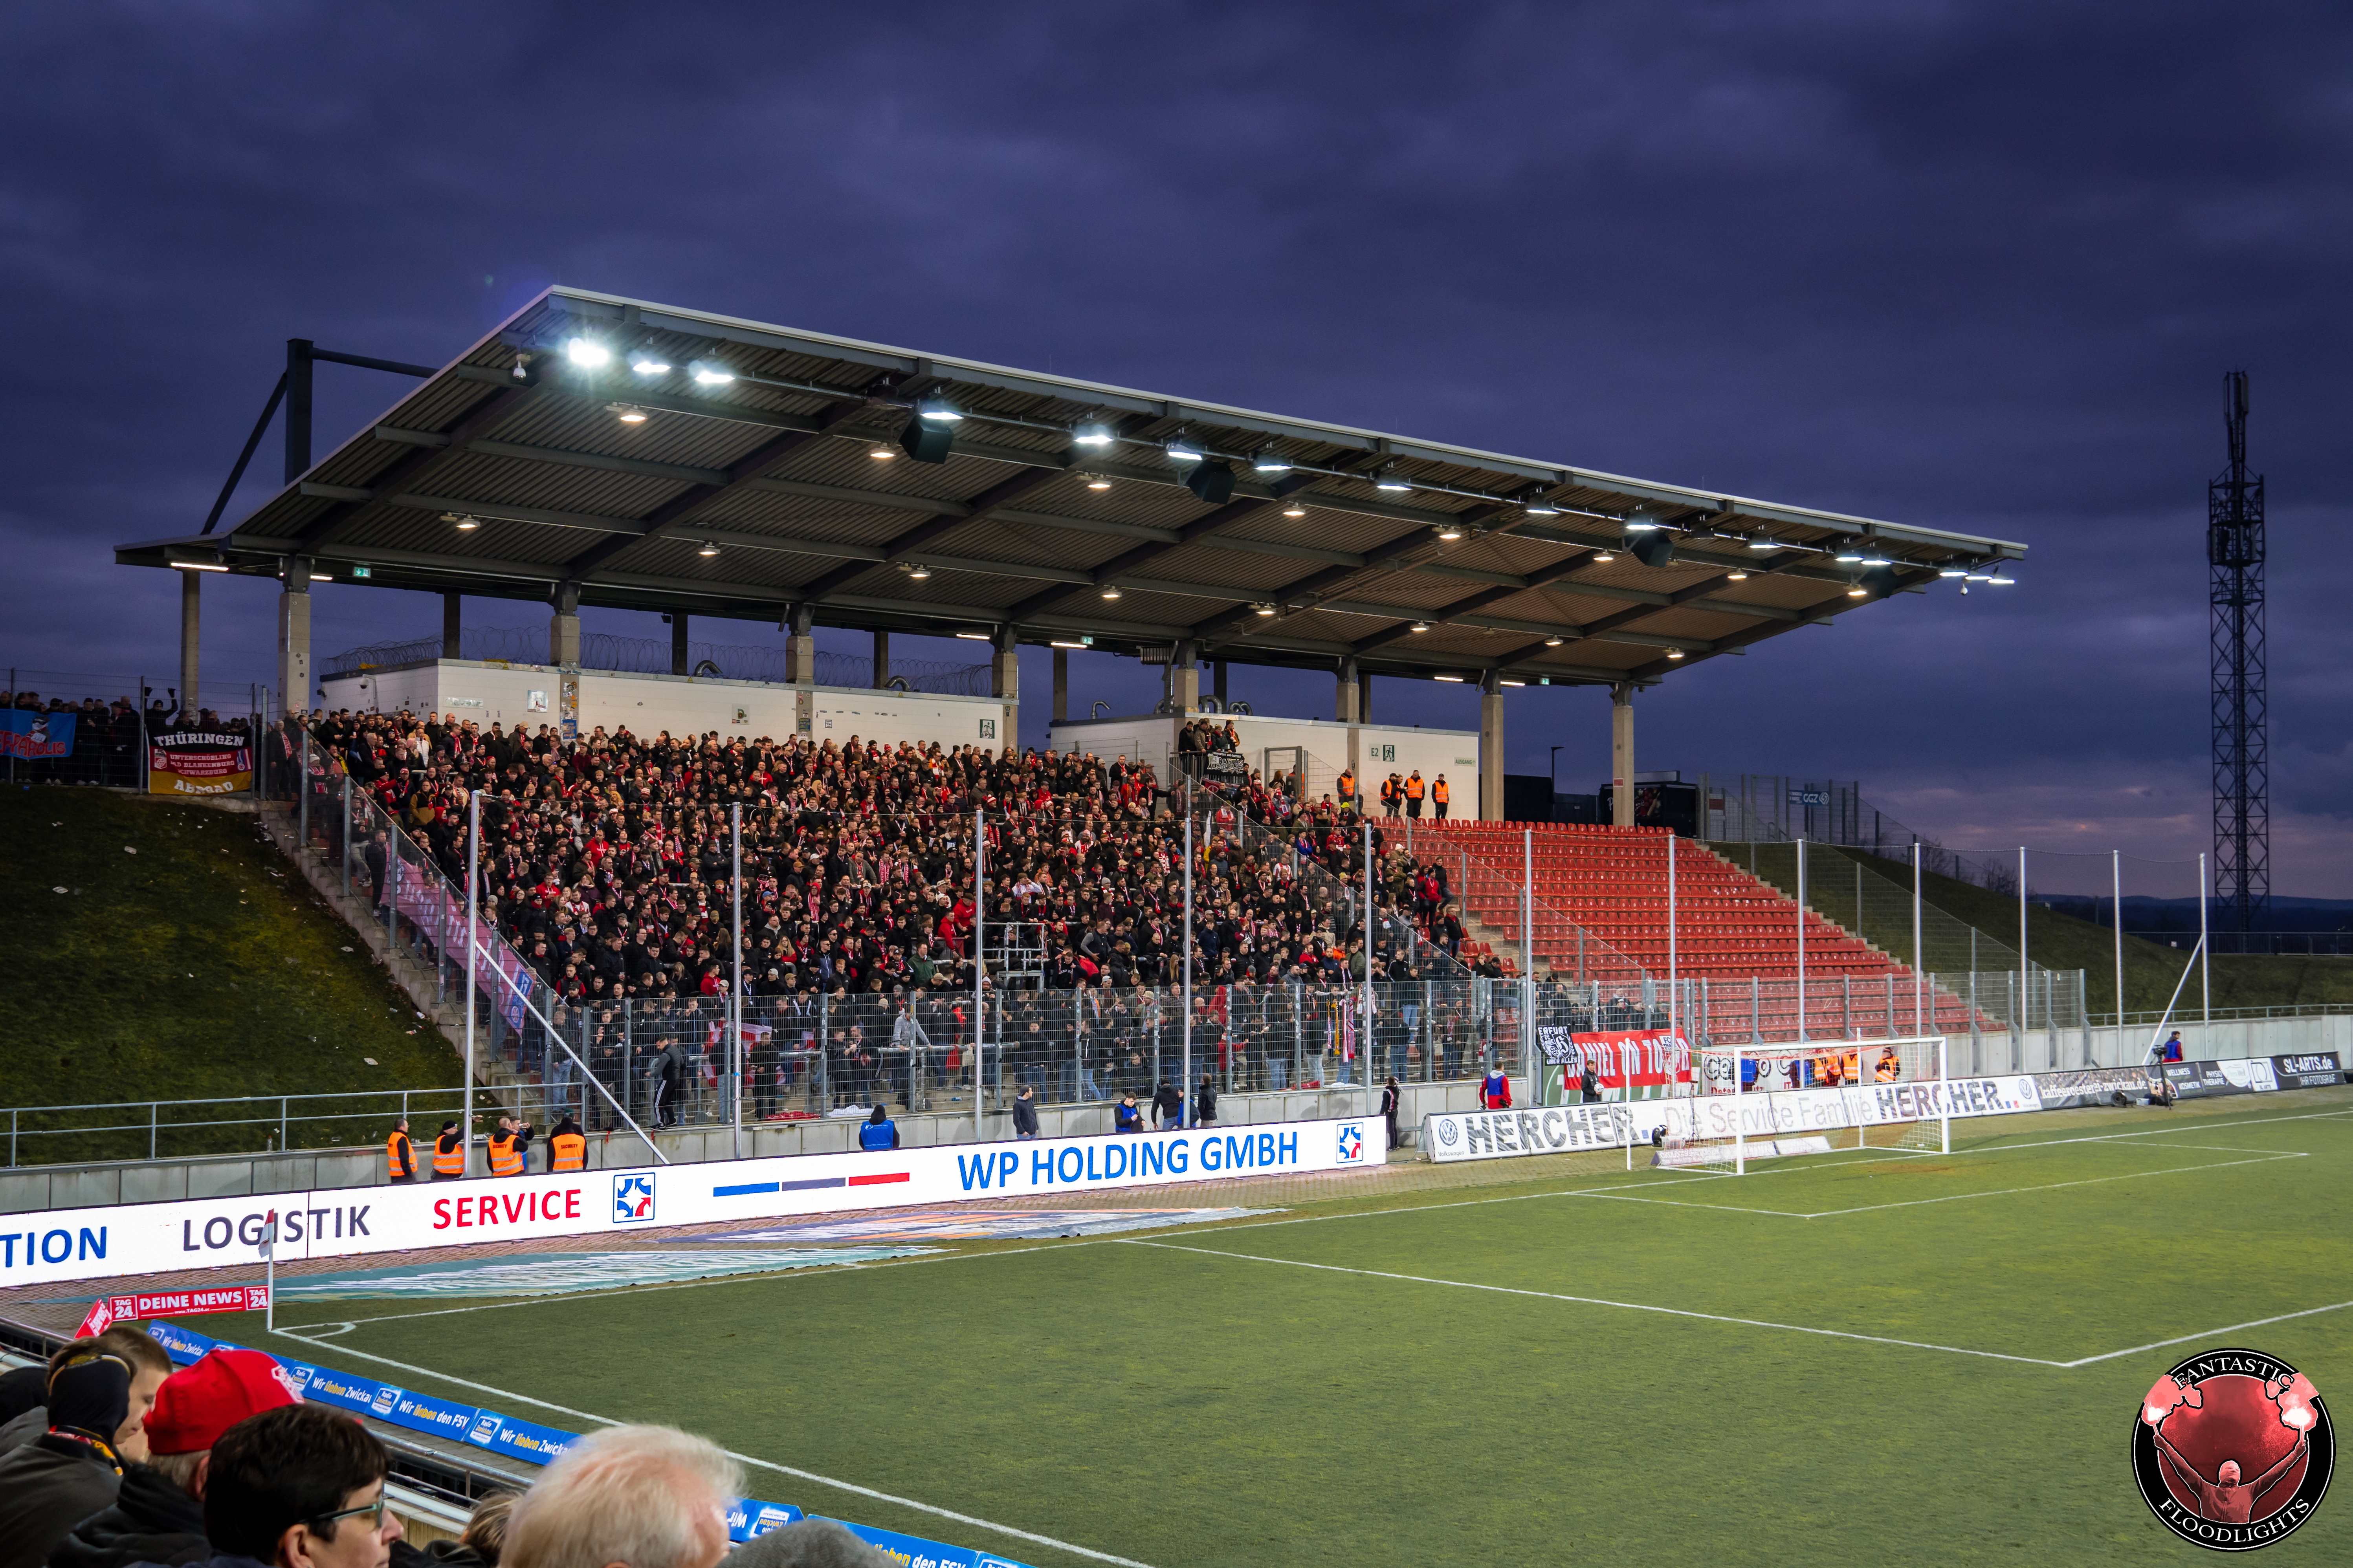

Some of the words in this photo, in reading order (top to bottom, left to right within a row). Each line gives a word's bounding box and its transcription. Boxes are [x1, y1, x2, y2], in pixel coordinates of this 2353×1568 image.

[154, 731, 244, 746] THÜRINGEN
[1371, 747, 1378, 757] E2
[1803, 793, 1819, 803] GGZ
[1538, 1026, 1568, 1035] ERFURT
[2283, 1055, 2333, 1073] SL-ARTS.de
[2166, 1068, 2191, 1077] WELLNESS
[2178, 1081, 2201, 1090] KOSMETIK
[2203, 1077, 2225, 1086] THERAPIE
[2300, 1076, 2310, 1085] IHR
[2310, 1074, 2336, 1084] FOTOGRAF
[2039, 1077, 2148, 1099] kaffeeroesterei-zwickau.de
[1663, 1106, 1703, 1136] Die
[1709, 1100, 1794, 1133] Service
[1798, 1094, 1873, 1126] Familie
[957, 1152, 1019, 1191] WP
[1032, 1139, 1189, 1185] HOLDING
[1200, 1131, 1298, 1171] GMBH
[183, 1205, 371, 1252] LOGISTIK
[433, 1189, 581, 1229] SERVICE
[139, 1293, 190, 1311] DEINE
[193, 1291, 243, 1306] NEWS
[250, 1295, 268, 1308] 24
[115, 1306, 133, 1318] 24
[162, 1336, 172, 1347] Wir
[170, 1339, 186, 1352] lieben
[296, 1369, 306, 1377] Radio
[312, 1377, 326, 1390] Wir
[323, 1380, 347, 1396] lieben
[381, 1390, 392, 1399] Radio
[375, 1396, 392, 1406] Zwickau
[398, 1399, 414, 1414] Wir
[413, 1404, 437, 1421] lieben
[436, 1410, 453, 1425] den
[451, 1414, 470, 1430] FSV
[480, 1419, 492, 1428] Radio
[475, 1425, 492, 1435] Zwickau
[499, 1428, 515, 1443] Wir
[514, 1433, 540, 1450] lieben
[727, 1511, 748, 1529] Wir
[759, 1519, 783, 1527] Zwickau
